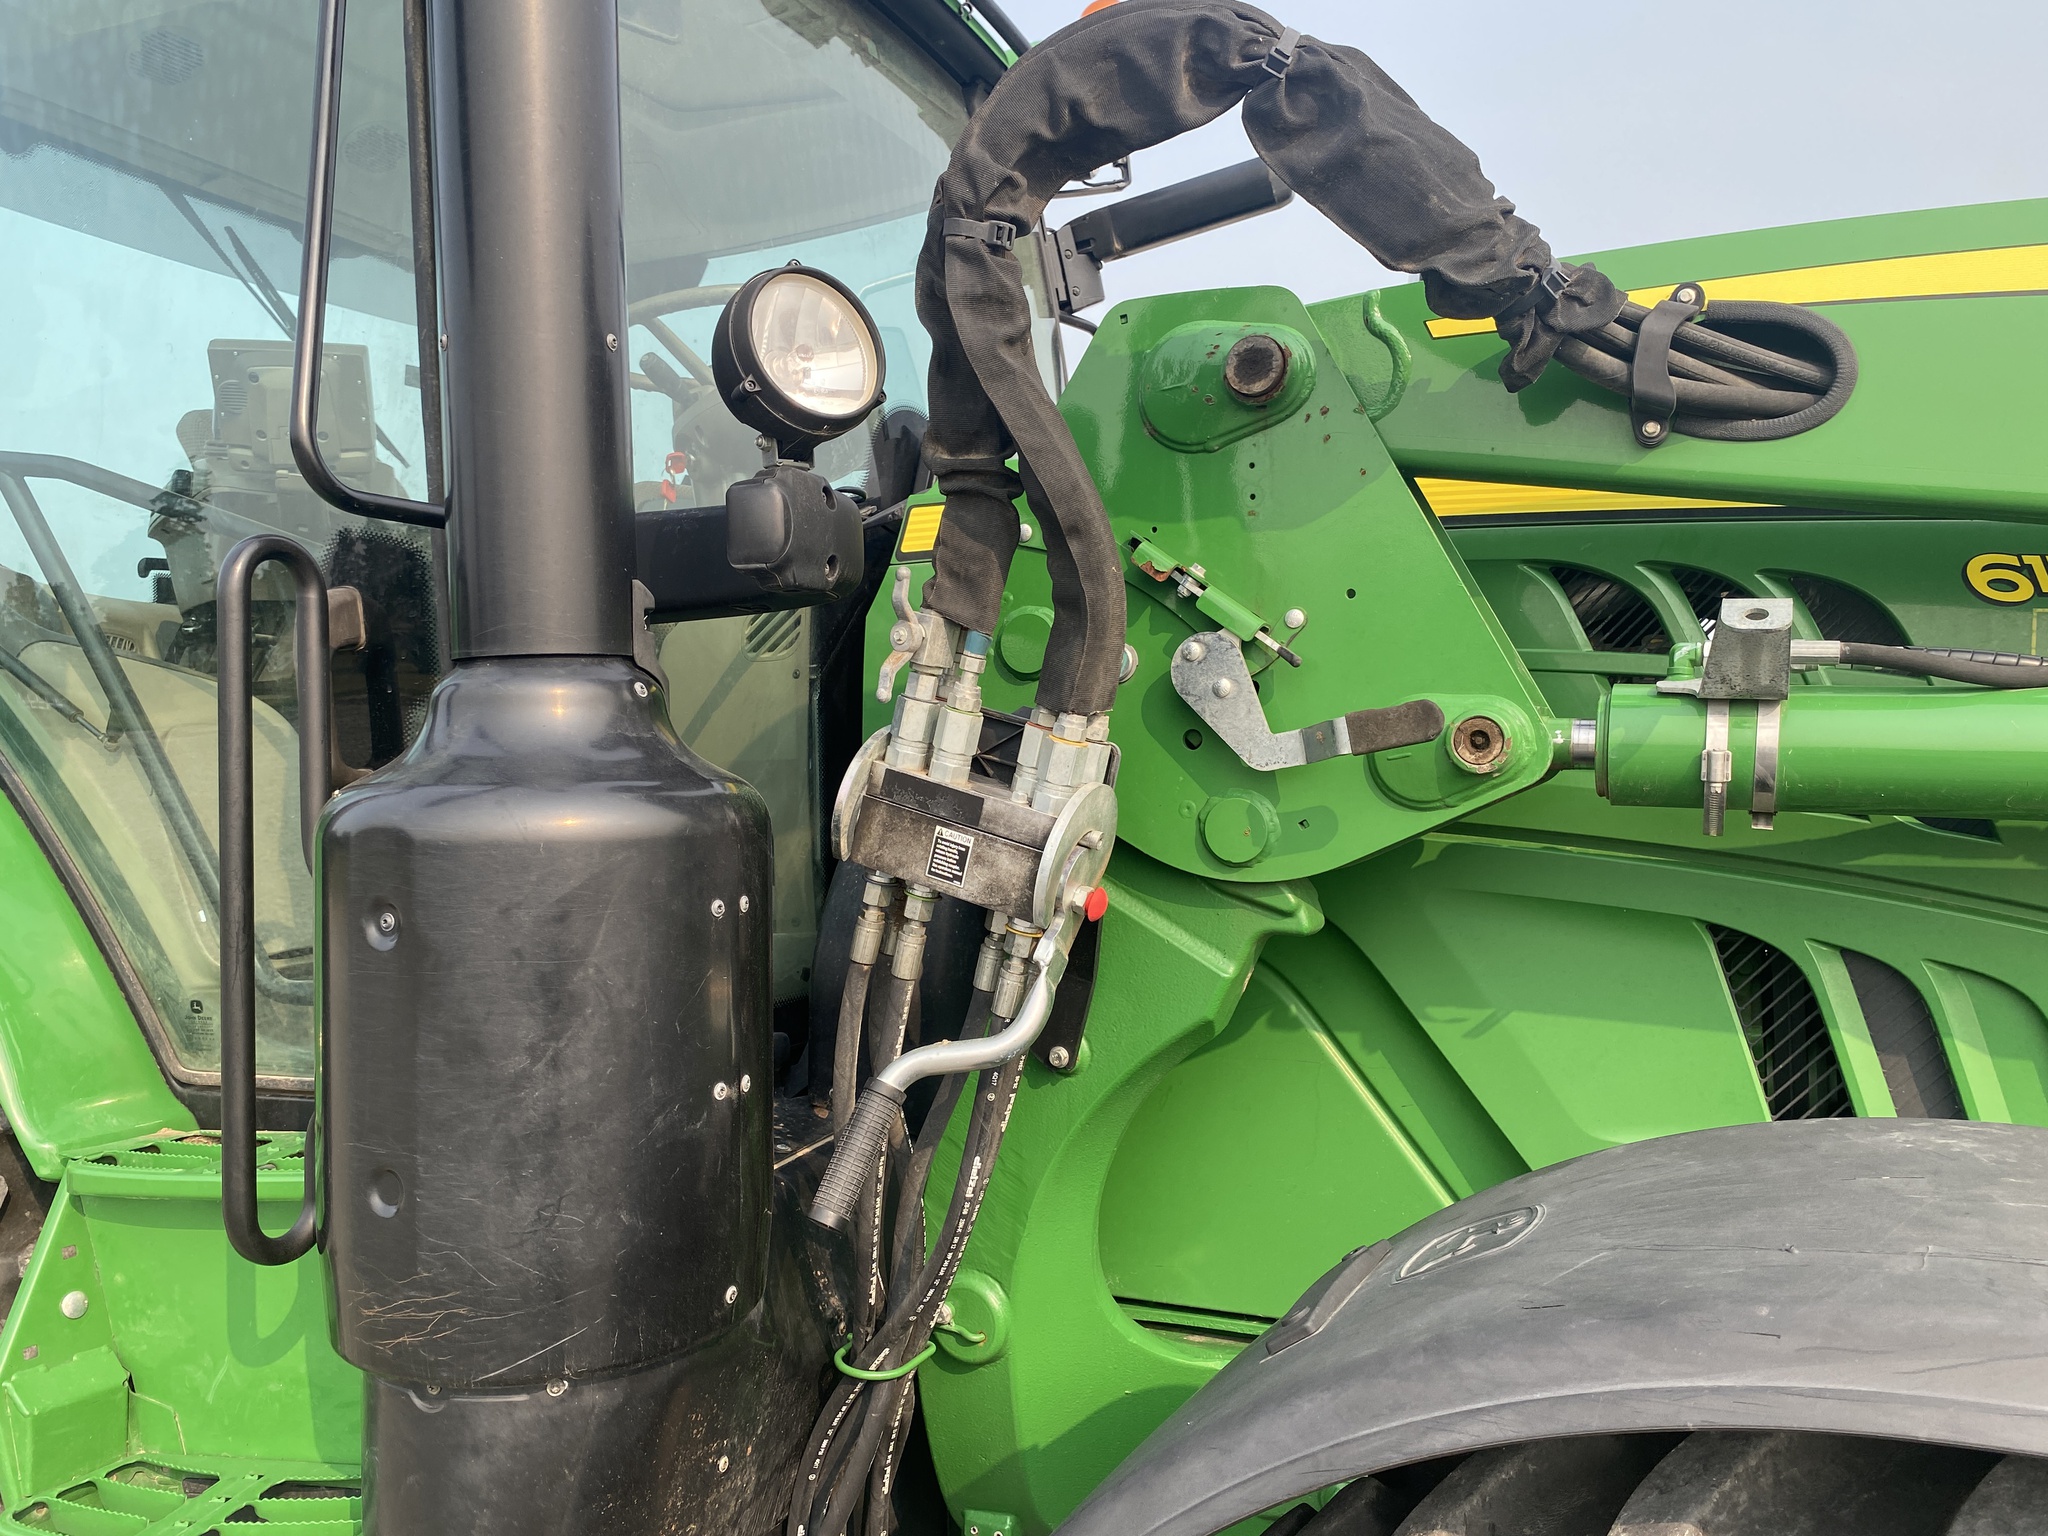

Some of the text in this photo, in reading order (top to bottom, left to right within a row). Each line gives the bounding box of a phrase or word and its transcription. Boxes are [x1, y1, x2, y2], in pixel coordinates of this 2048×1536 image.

[1964, 553, 2048, 606] 61
[945, 830, 972, 844] CAUTION
[991, 1071, 999, 1086] 4Q17
[965, 1156, 982, 1198] dietzel
